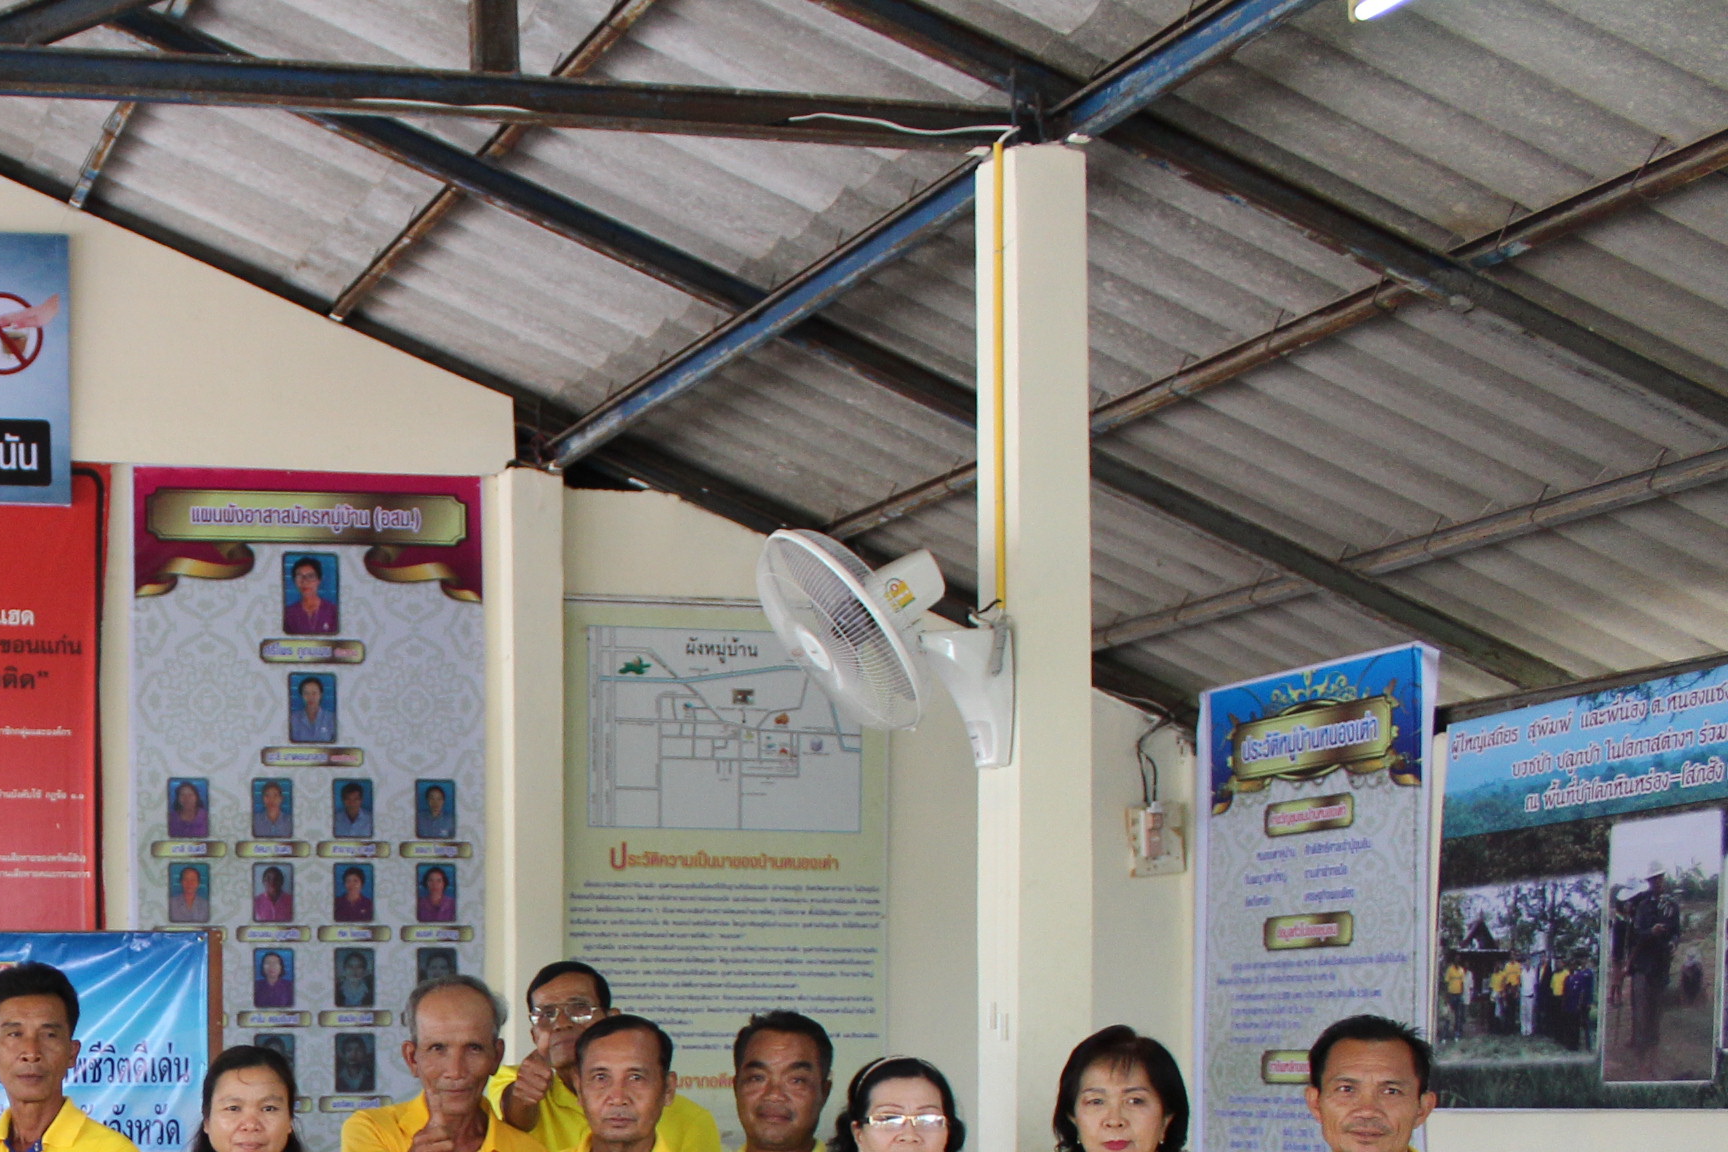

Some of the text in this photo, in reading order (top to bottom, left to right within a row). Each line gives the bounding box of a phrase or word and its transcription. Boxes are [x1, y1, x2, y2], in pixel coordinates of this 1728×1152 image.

[190, 503, 370, 533] แผนผังอาสาสมัครหมู่บ้าน
[685, 635, 759, 675] ผังหมู่บ้าน
[1241, 709, 1379, 763] ประวัติหมู่บ้านหนองเต่า
[1451, 725, 1519, 760] ผู้ใหญ่เสถียร
[1527, 711, 1573, 745] สุพิมพ์
[1580, 692, 1647, 730] และพี่น้อง
[1512, 750, 1553, 779] บวชป่า
[1556, 744, 1601, 777] ปลูกป่า
